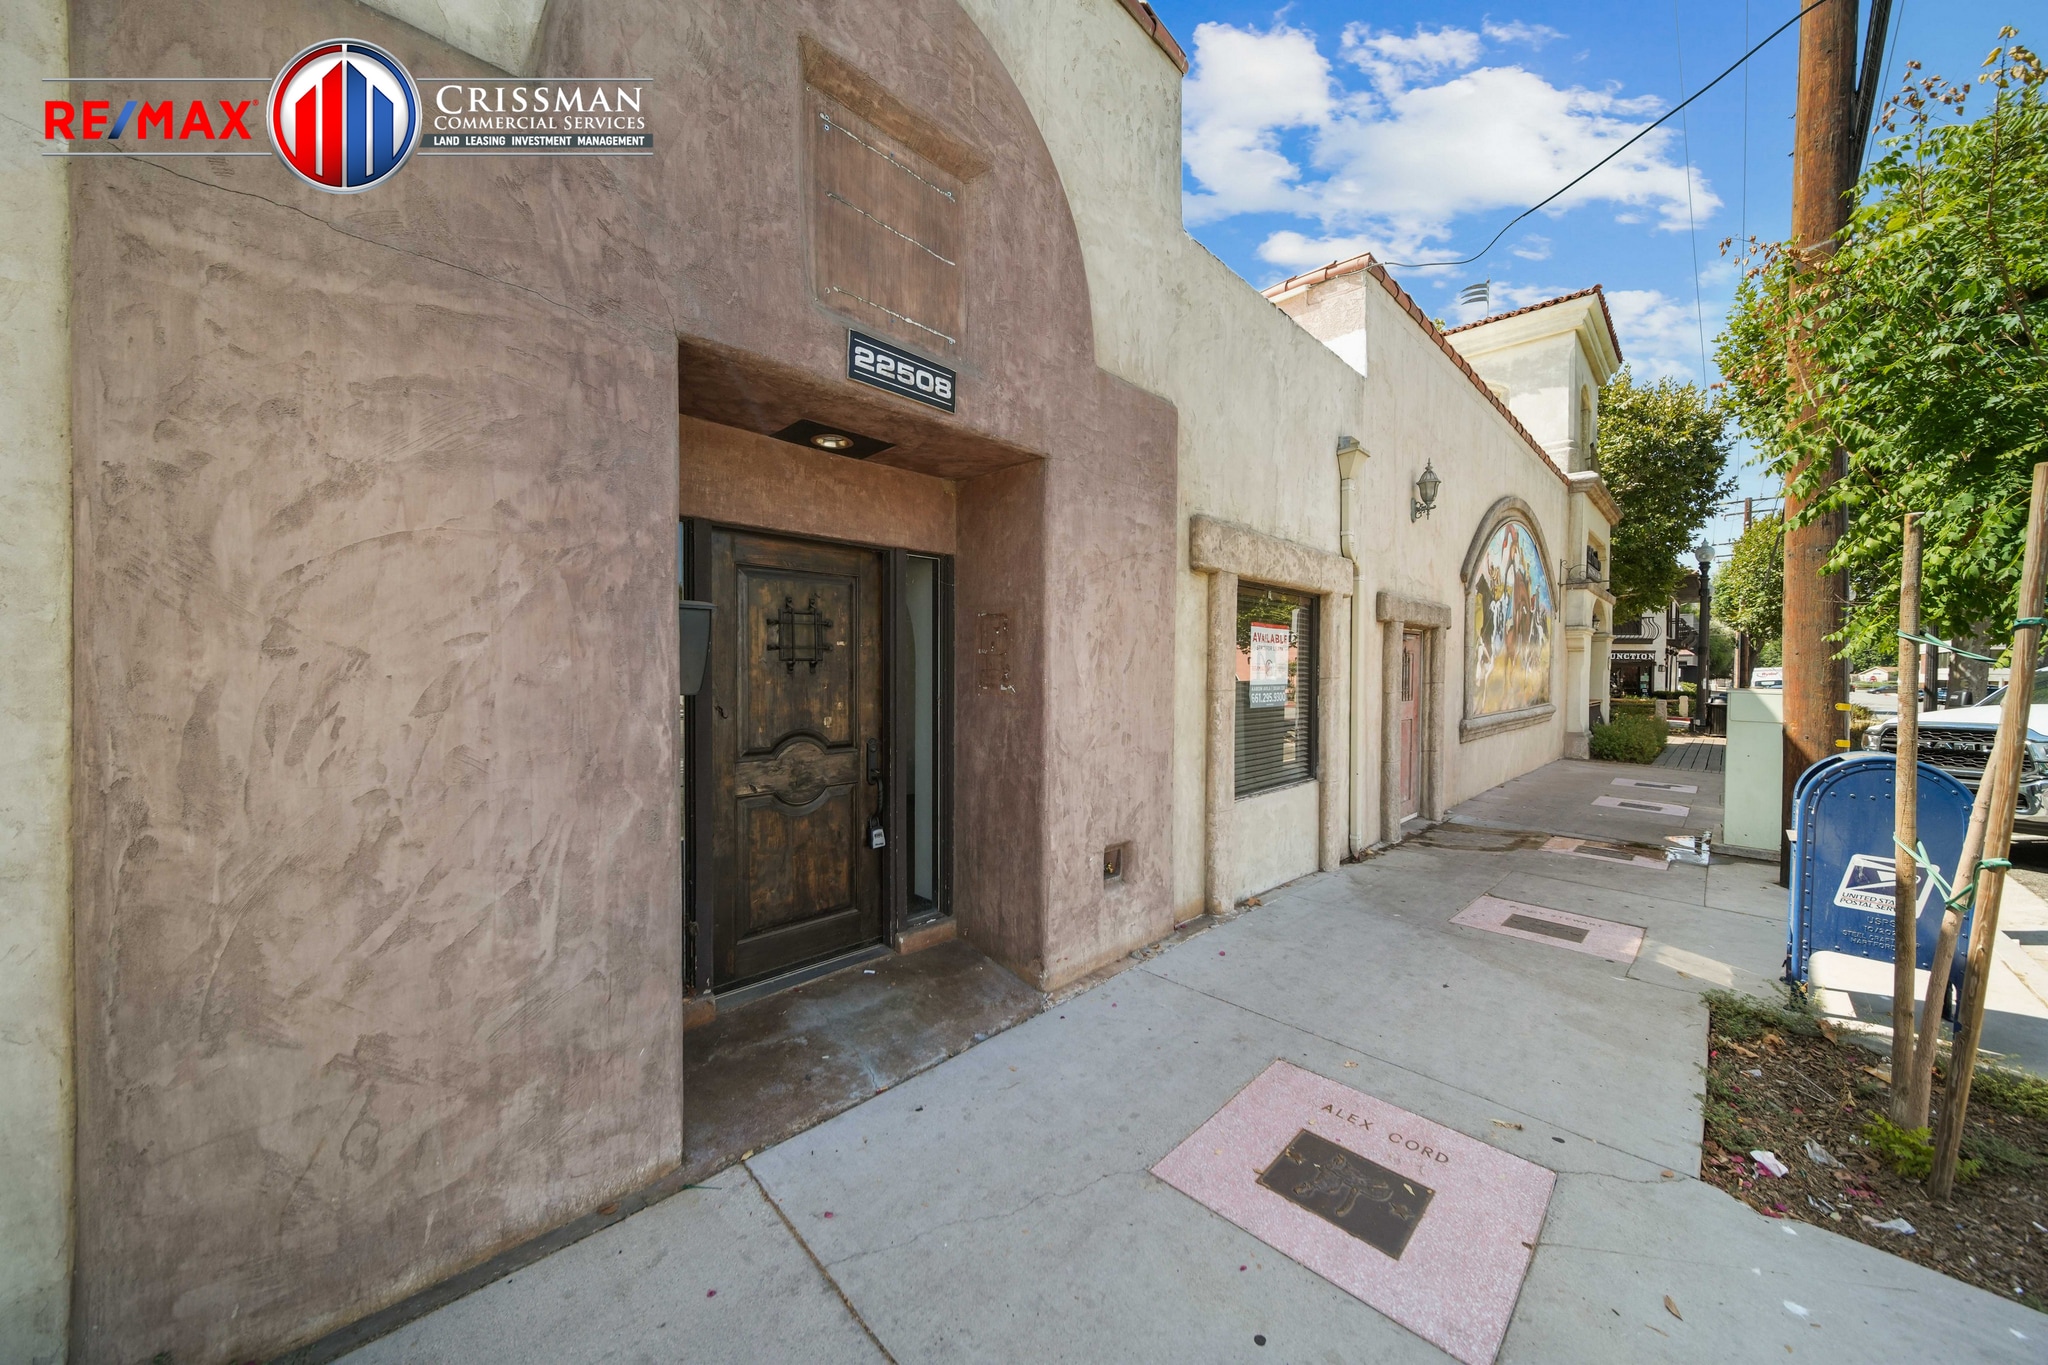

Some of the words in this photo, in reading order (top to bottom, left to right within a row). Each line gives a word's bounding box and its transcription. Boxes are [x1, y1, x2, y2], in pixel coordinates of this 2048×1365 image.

[854, 346, 952, 399] 22508
[1252, 632, 1288, 644] AVAILABLE
[1840, 898, 1873, 909] POSTAL
[1842, 892, 1877, 902] UNITED
[1879, 898, 1896, 906] STA
[1867, 916, 1896, 928] USPS
[1321, 1104, 1373, 1131] ALEX
[1388, 1132, 1449, 1163] CORD
